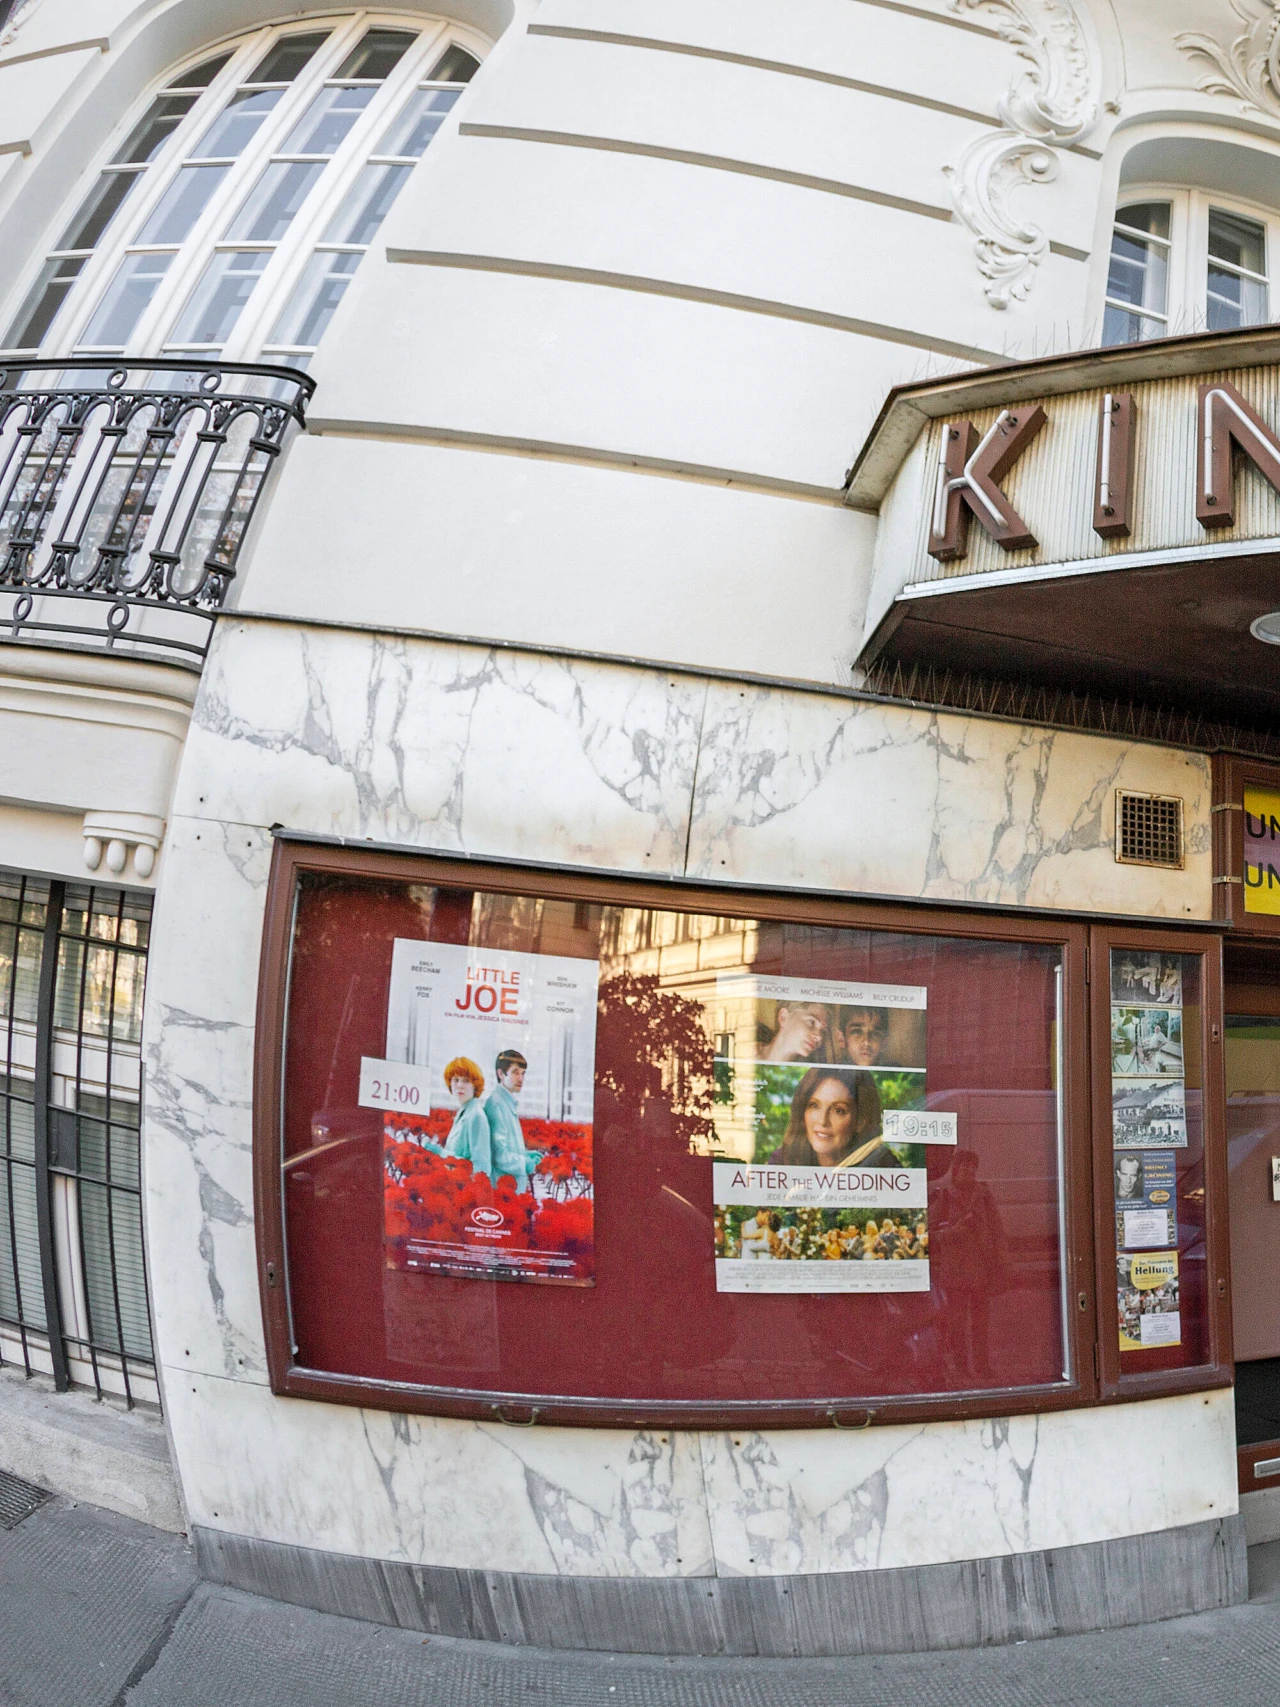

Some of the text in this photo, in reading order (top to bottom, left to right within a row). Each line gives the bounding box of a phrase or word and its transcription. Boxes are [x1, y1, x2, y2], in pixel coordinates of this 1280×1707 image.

[466, 966, 521, 985] LITTLE
[455, 984, 519, 1015] JOE
[763, 986, 790, 994] MOORE
[546, 1005, 575, 1014] CONNOR
[371, 1080, 420, 1106] 21:00
[885, 1114, 953, 1137] 19:15
[731, 1170, 911, 1191] AFTER THE WEDDING
[1135, 1265, 1175, 1275] Heilung
